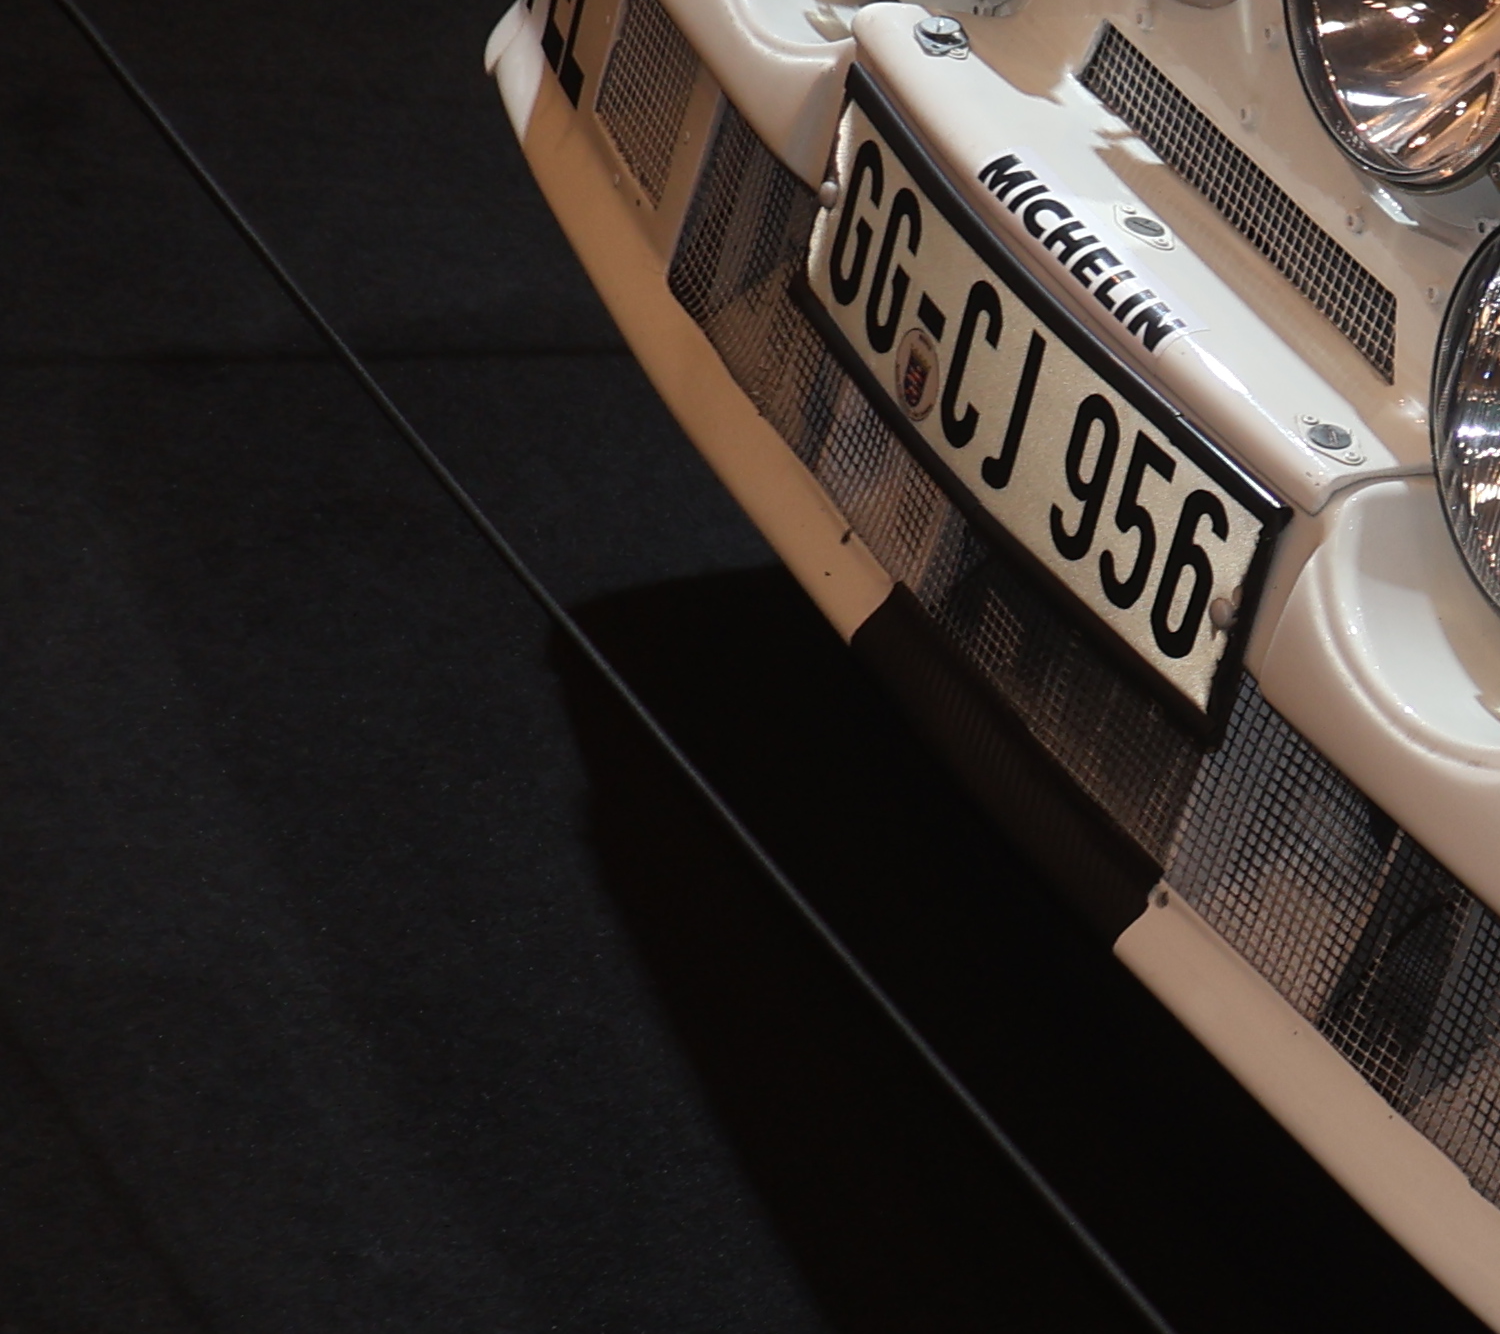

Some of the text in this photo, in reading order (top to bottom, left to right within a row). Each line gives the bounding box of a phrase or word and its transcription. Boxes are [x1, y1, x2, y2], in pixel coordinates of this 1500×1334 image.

[830, 140, 1229, 659] GG-CJ 956
[978, 154, 1186, 353] MICHELIN
